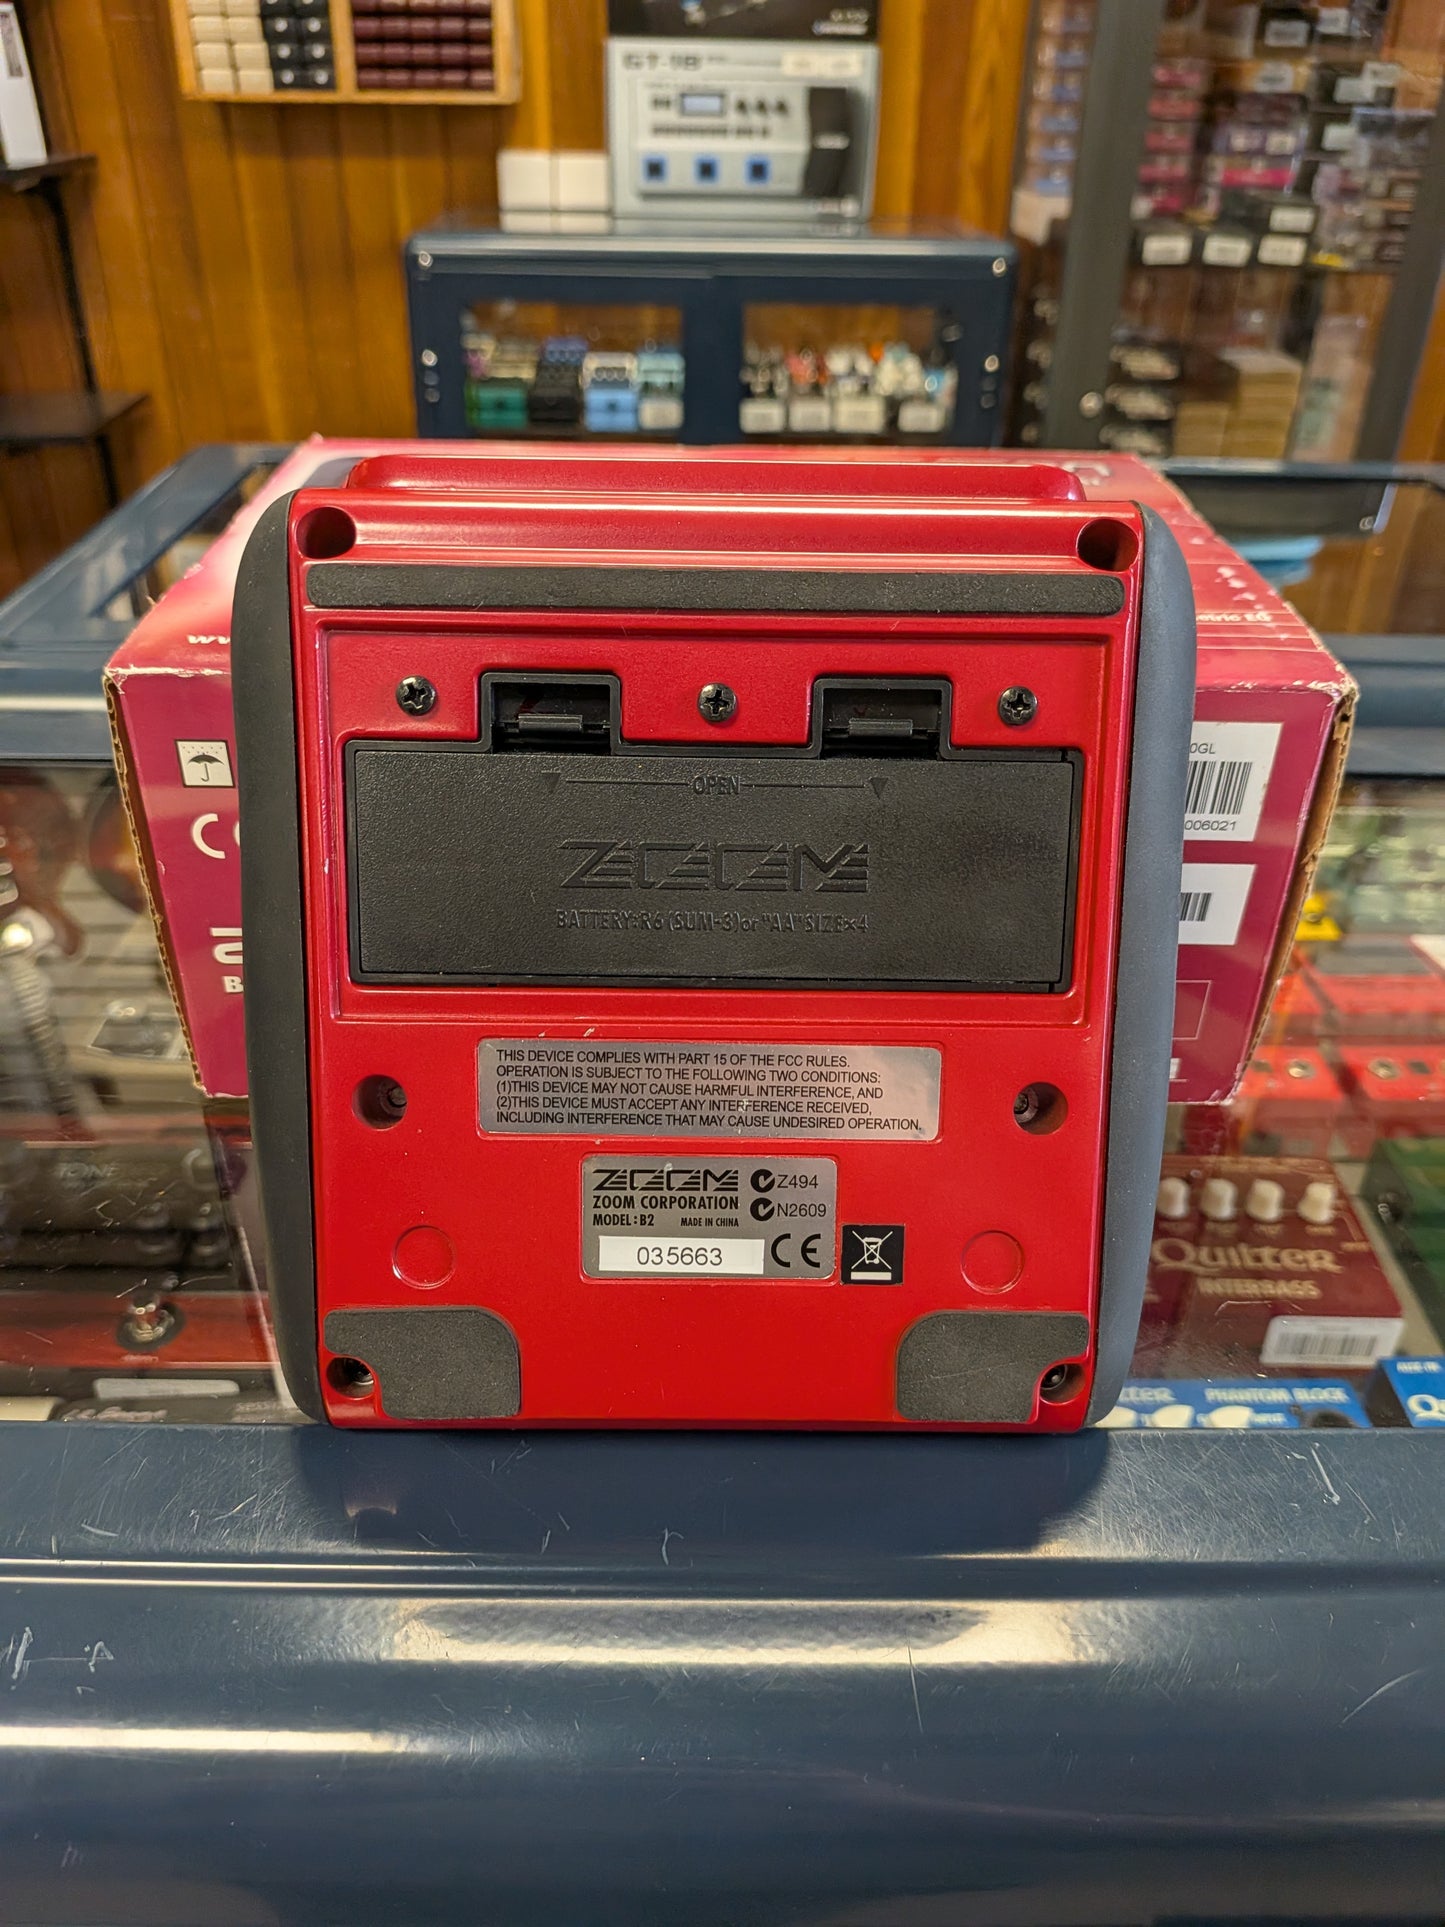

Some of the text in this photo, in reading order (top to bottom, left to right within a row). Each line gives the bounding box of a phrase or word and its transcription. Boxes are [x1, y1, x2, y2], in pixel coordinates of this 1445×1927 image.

[692, 775, 741, 795] OPEN
[558, 840, 870, 892] ZOOM
[496, 1050, 850, 1068] THIS DEVICE COMPLIES WITH PART 15 OF THE FCC RULES.
[496, 1065, 881, 1084] OPERATION IS SUBJECT TO THE FOLLOWING TWO CONDITIONS:
[542, 1082, 589, 1094] DEVICE
[591, 1082, 618, 1094] MAY
[620, 1083, 647, 1095] NOT
[650, 1083, 691, 1095] CAUSE
[695, 1084, 754, 1097] HARMFUL
[756, 1085, 855, 1100] INTERFERENCE,
[857, 1087, 884, 1099] AND
[542, 1097, 588, 1109] DEVICE
[591, 1097, 626, 1109] MUST
[628, 1098, 678, 1110] ACCEPT
[680, 1099, 706, 1111] ANY
[708, 1100, 806, 1113] INTERFERENCE
[806, 1101, 873, 1115] RECEIVED,
[496, 1111, 922, 1131] INCLUDING INTERFERENCE THAT MAY CAUSE UNDESIRED OPERATION.
[592, 1169, 739, 1192] ZOOM
[777, 1174, 819, 1190] Z494
[593, 1195, 739, 1210] ZOOM CORPORATION
[776, 1203, 827, 1218] N2609
[681, 1217, 739, 1227] MADE IN CHINA
[636, 1246, 723, 1267] 035663
